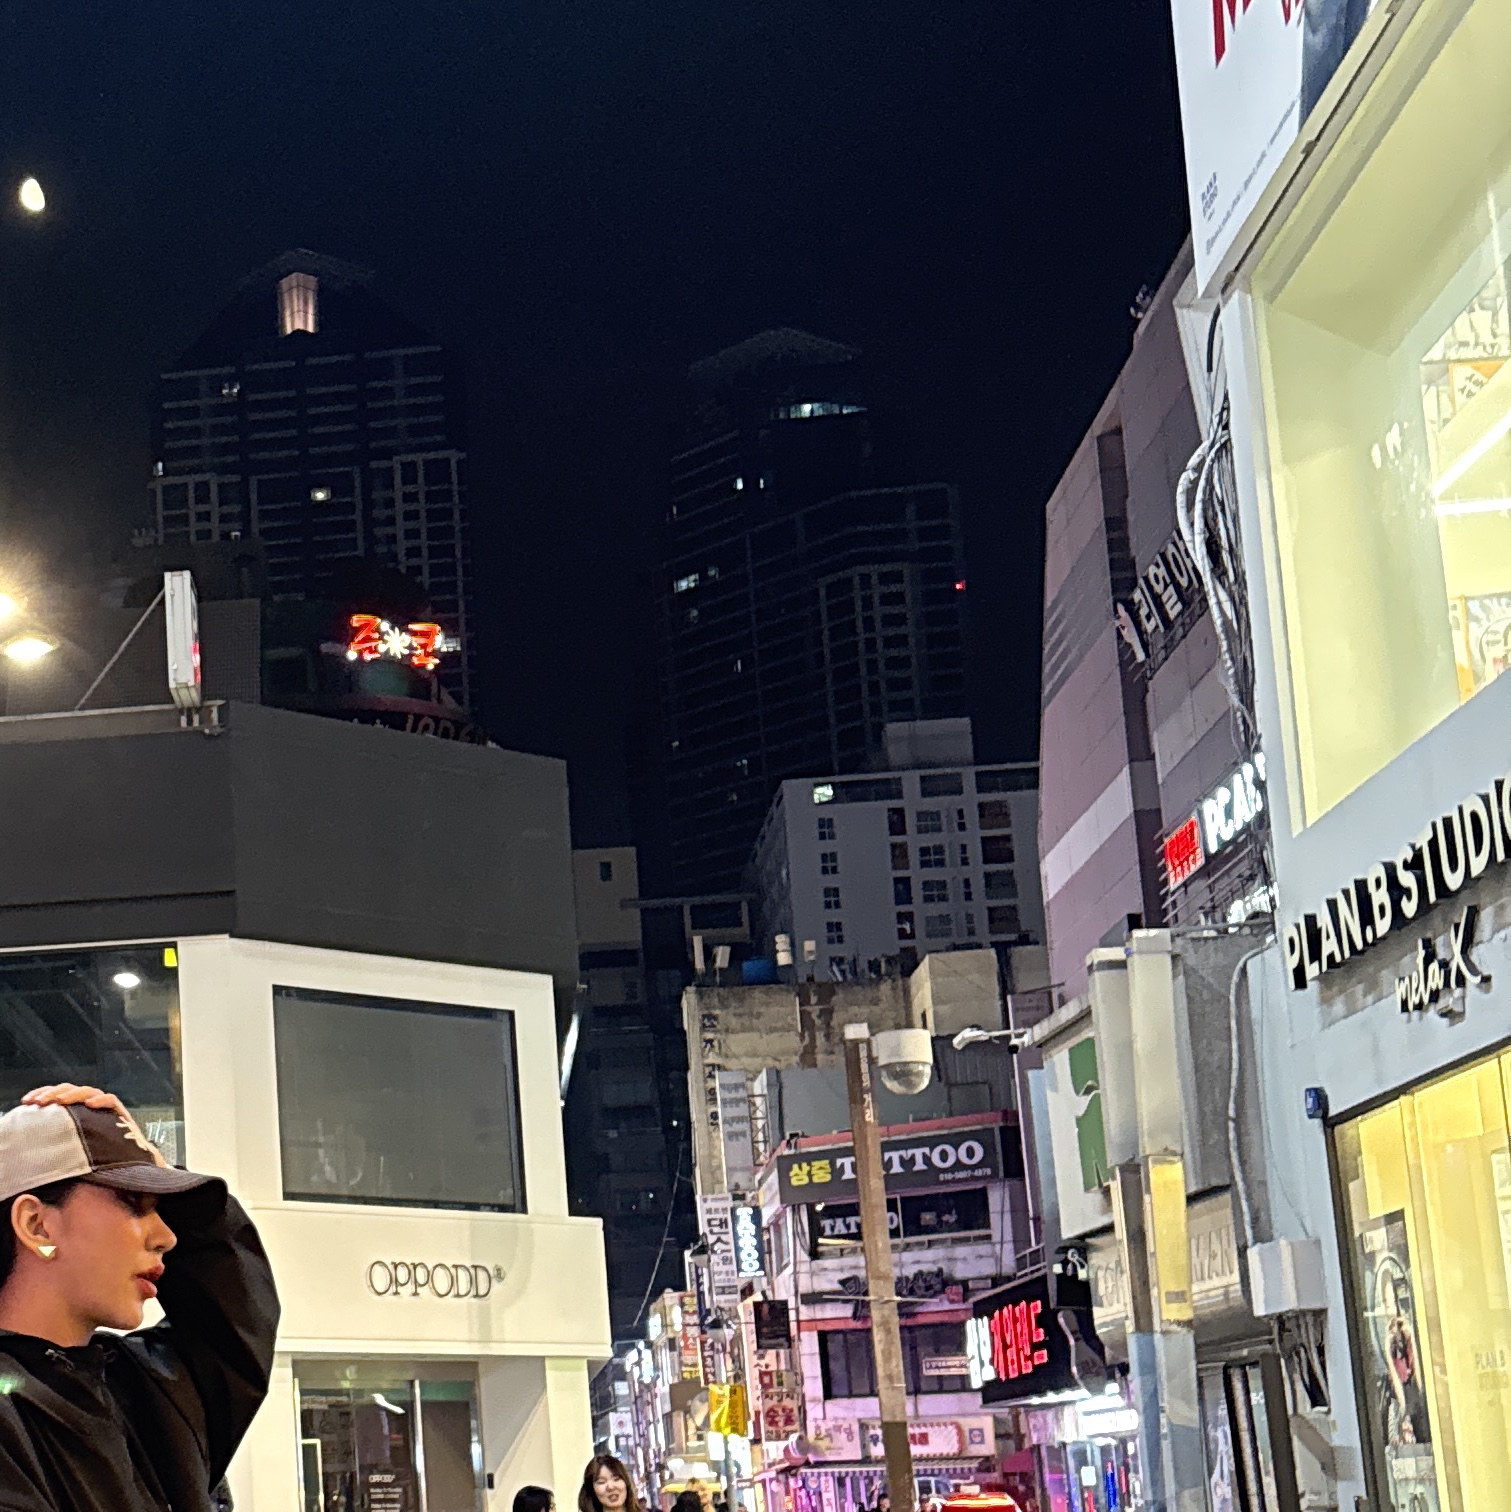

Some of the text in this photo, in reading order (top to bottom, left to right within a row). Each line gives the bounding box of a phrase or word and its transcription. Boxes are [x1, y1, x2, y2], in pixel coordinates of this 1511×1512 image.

[1284, 861, 1392, 990] PLAN.B
[790, 1141, 984, 1187] 상중 TTTOO
